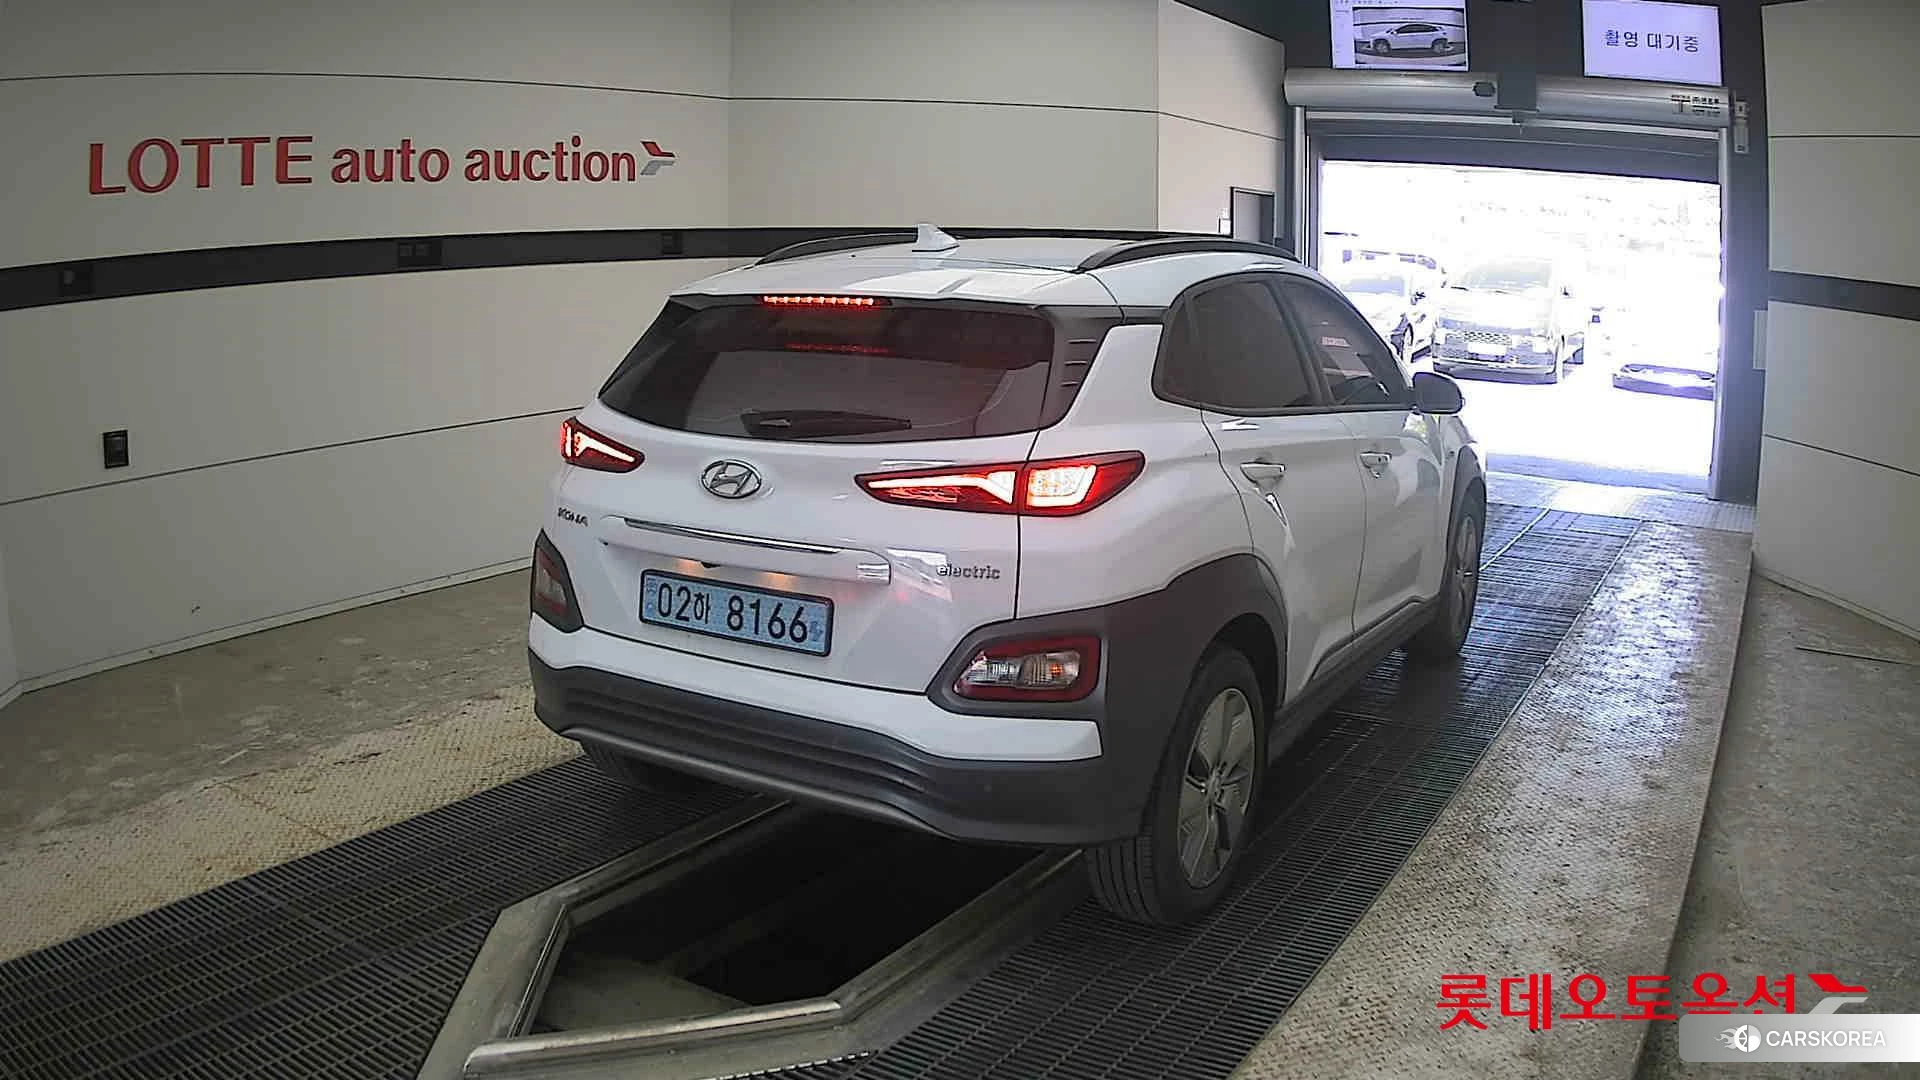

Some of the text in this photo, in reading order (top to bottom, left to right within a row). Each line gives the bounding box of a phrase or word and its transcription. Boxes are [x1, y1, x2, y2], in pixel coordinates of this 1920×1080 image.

[1647, 33, 1698, 52] 대기중
[89, 135, 636, 195] LOTTE auto auction
[936, 562, 1001, 579] electric
[658, 583, 711, 625] 02하
[727, 595, 808, 643] 8166
